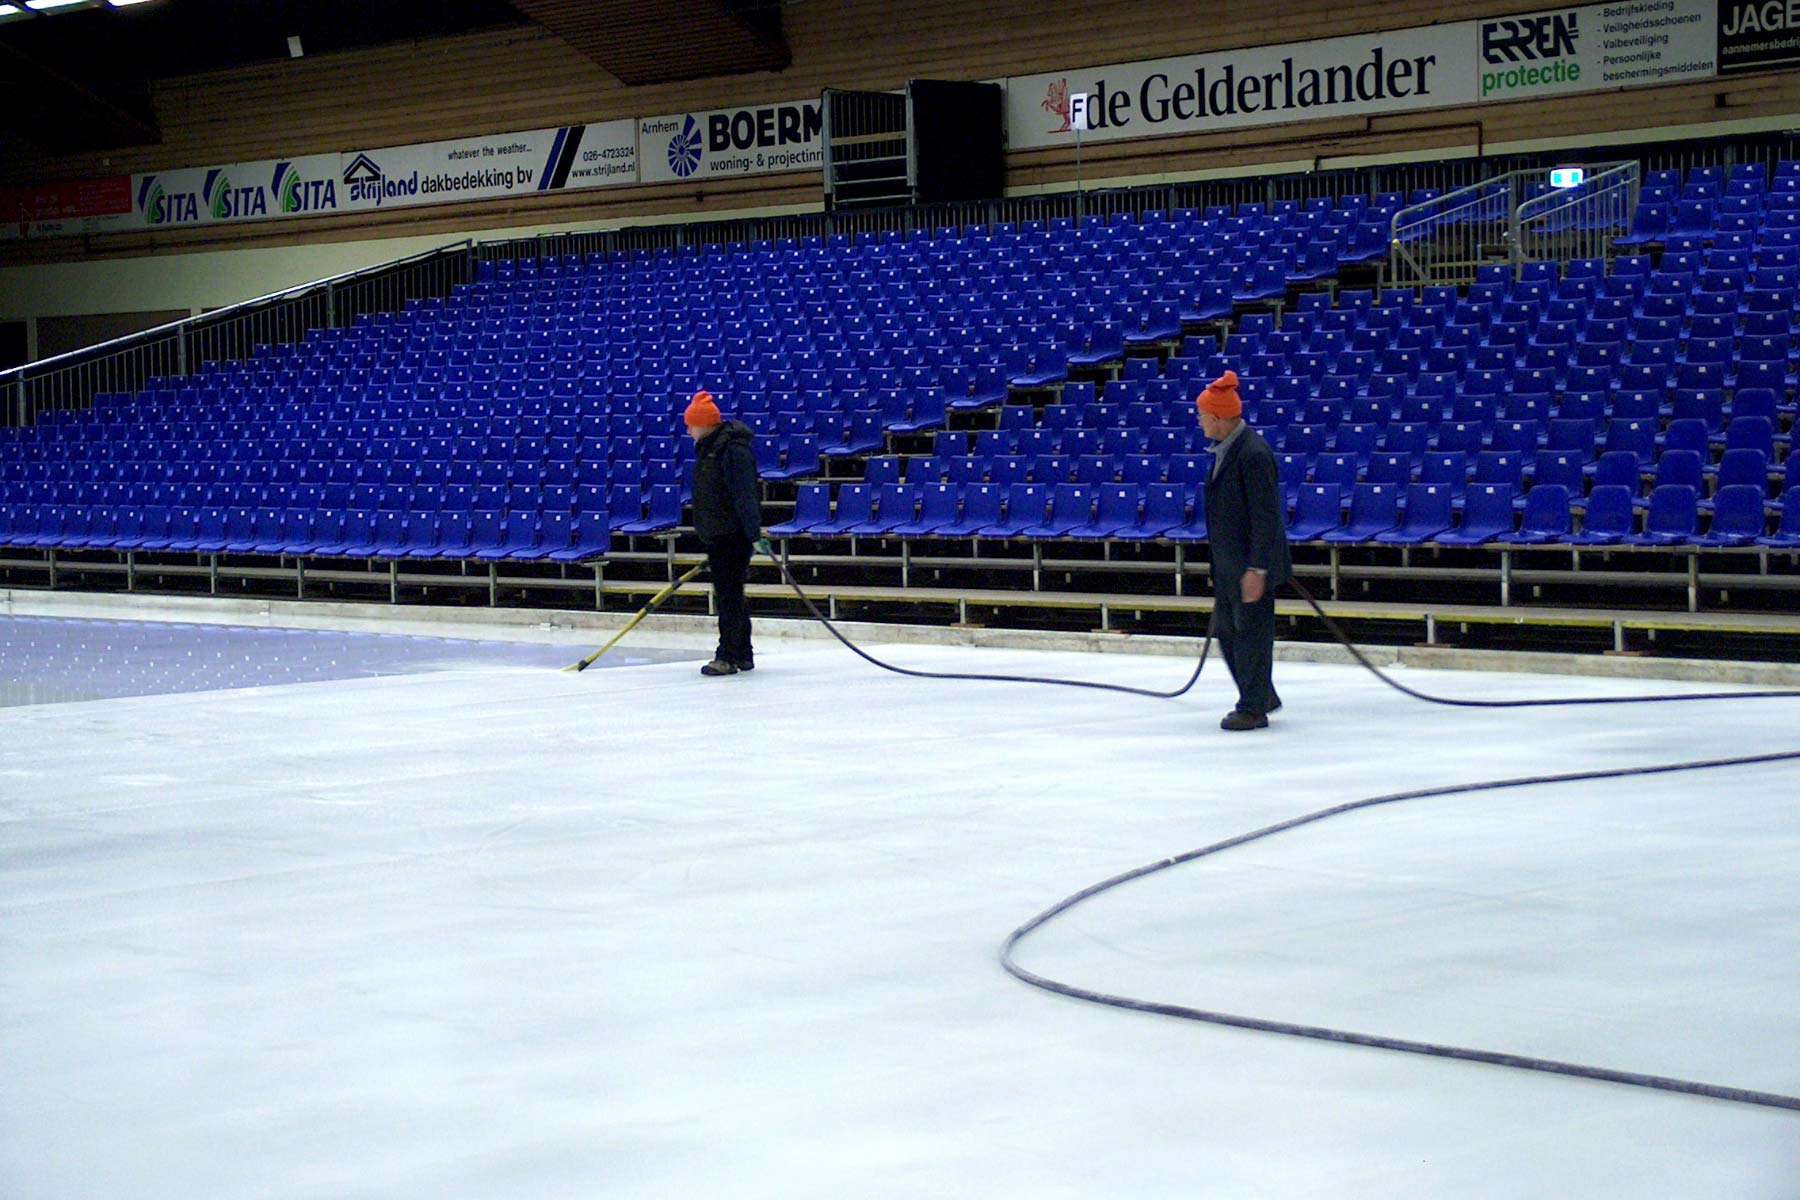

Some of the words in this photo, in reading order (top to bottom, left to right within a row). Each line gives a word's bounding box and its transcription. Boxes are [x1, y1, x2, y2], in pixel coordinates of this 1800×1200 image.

[1603, 13, 1701, 33] Veiligheidsschoenen
[1722, 0, 1800, 36] JAGE
[1722, 36, 1800, 55] aannemersbedri
[1603, 50, 1662, 65] Persoonlijke
[1483, 59, 1580, 96] protectie
[1603, 61, 1714, 81] beschermingsmiddelen
[1087, 80, 1131, 130] de
[1141, 47, 1436, 123] Gelderlander
[1072, 98, 1084, 123] F
[642, 120, 679, 135] Arnhem
[448, 149, 480, 161] whatever
[482, 146, 495, 157] the
[710, 155, 753, 172] woning-
[756, 154, 765, 167] &
[572, 162, 636, 178] www.strijland.nl
[350, 170, 418, 207] strijland
[421, 168, 513, 194] dakbedekking
[517, 166, 533, 184] bv
[156, 193, 199, 224] SITA
[222, 186, 266, 218] SITA
[291, 179, 337, 213] SITA
